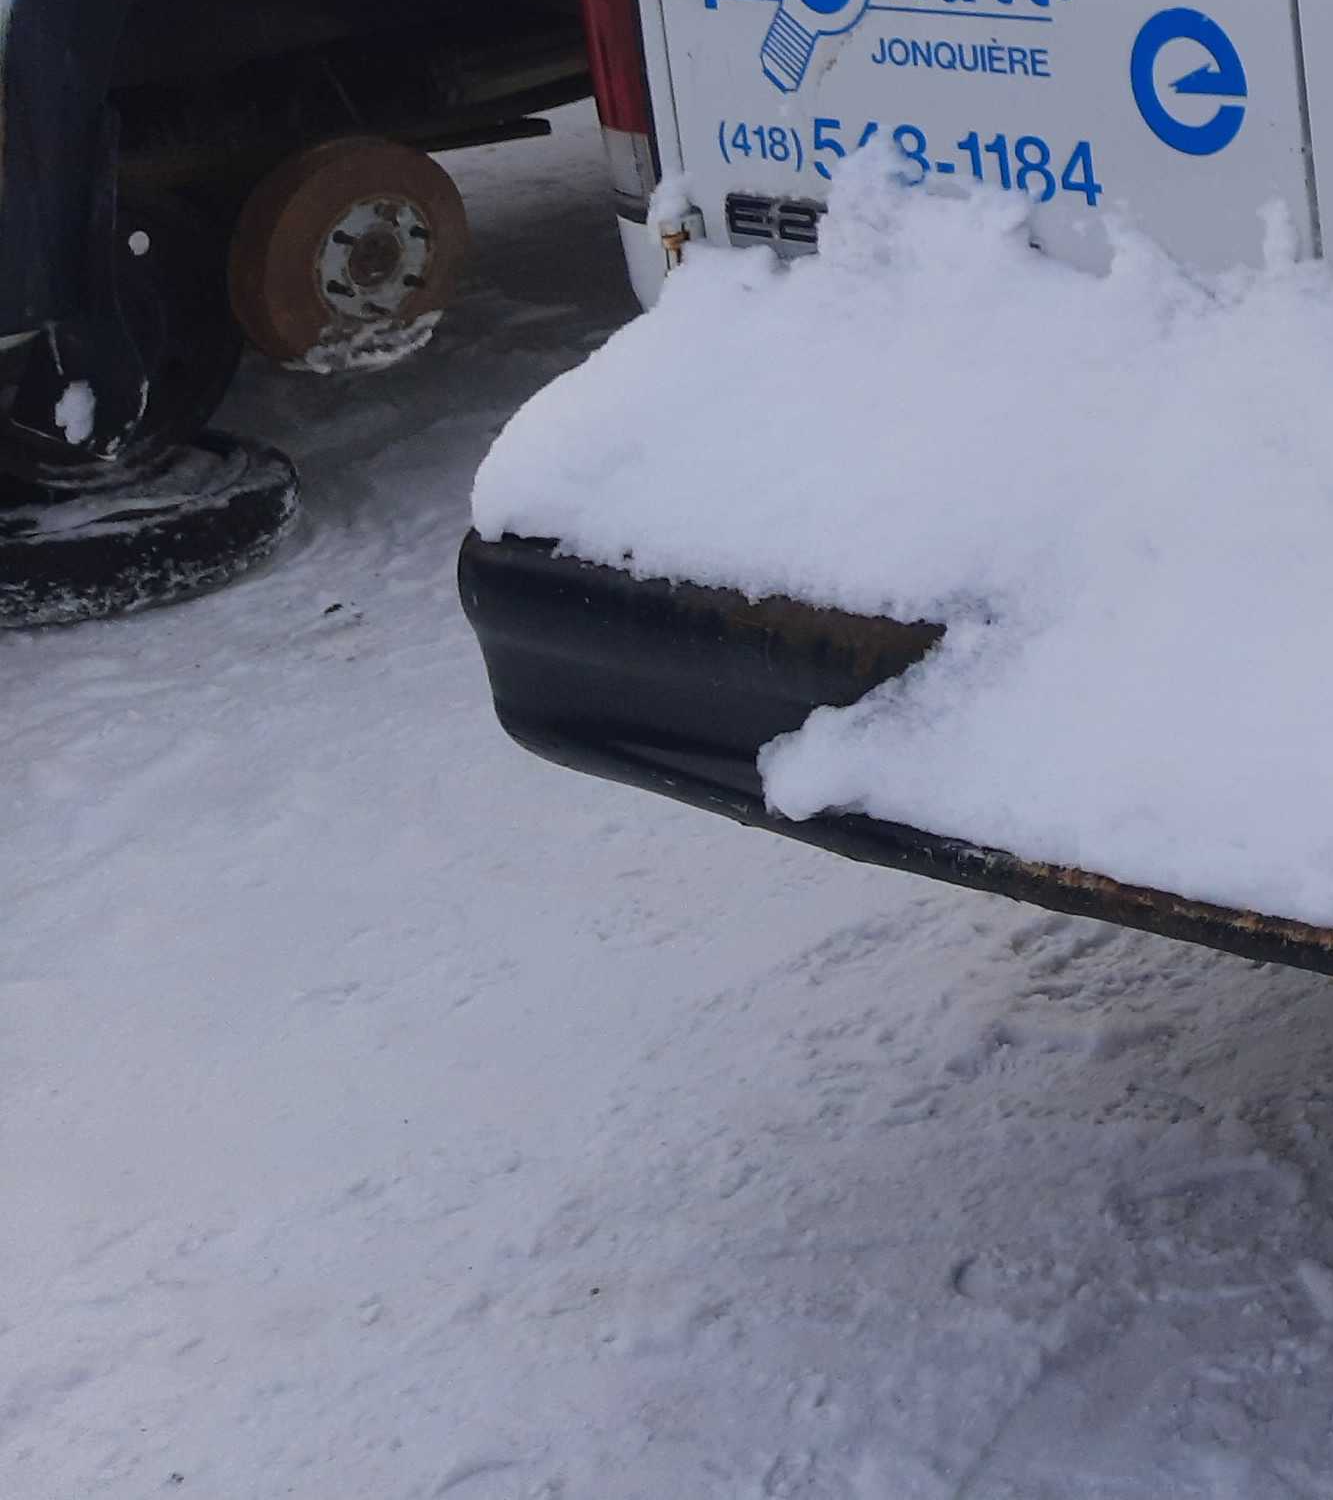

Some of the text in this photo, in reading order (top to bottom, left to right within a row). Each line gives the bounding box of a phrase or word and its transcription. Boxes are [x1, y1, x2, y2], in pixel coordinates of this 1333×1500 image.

[870, 36, 1051, 78] JONQUIÈRE
[717, 119, 803, 172] (418)
[725, 193, 830, 244] E-2
